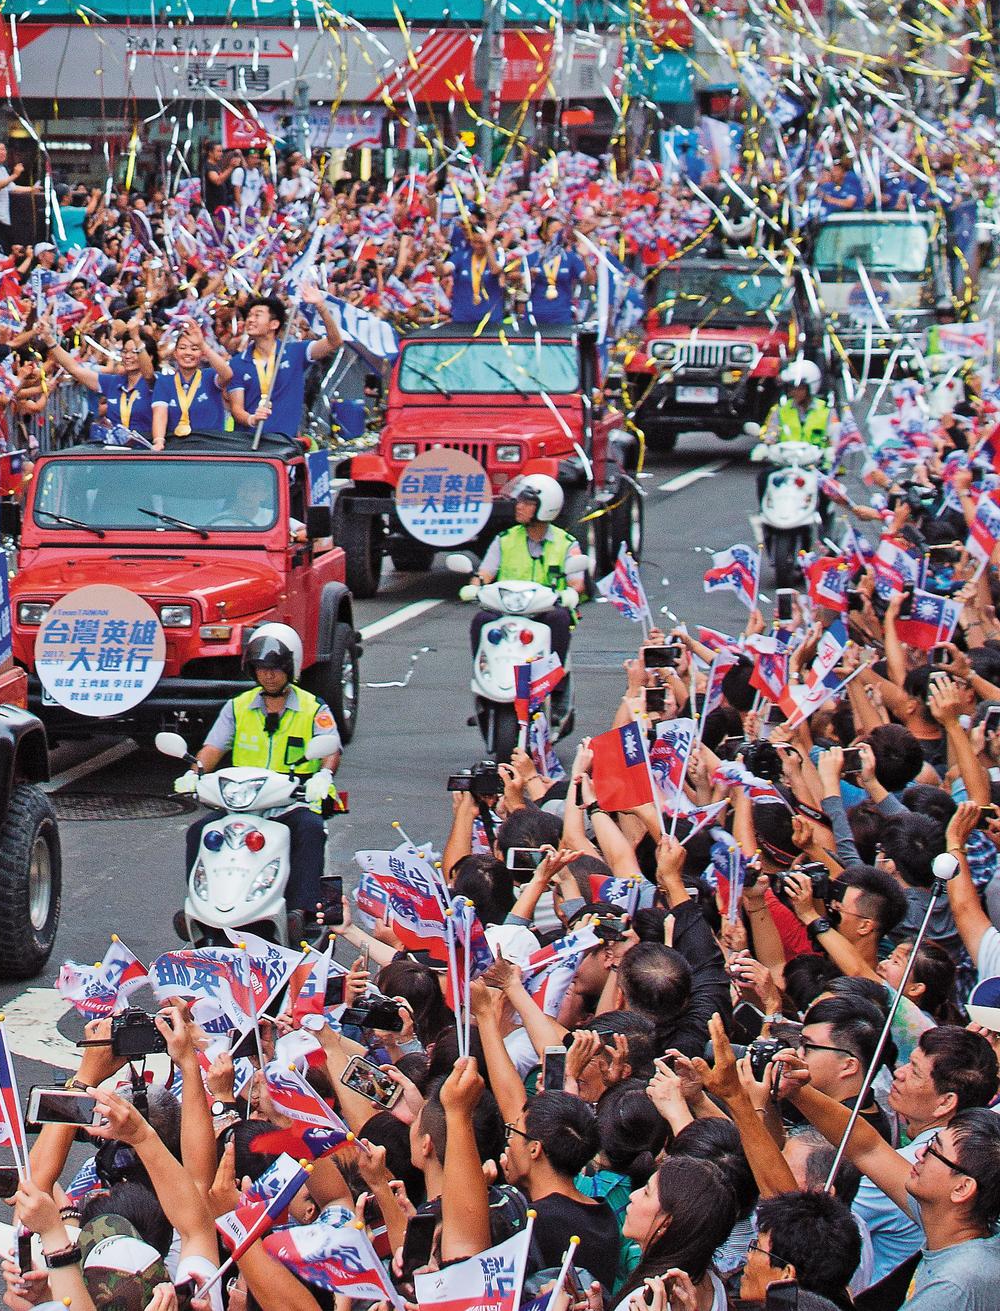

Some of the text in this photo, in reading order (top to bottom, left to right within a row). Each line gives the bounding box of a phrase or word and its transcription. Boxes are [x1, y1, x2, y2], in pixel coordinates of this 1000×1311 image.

[401, 474, 485, 493] 台灣英雄
[43, 619, 157, 645] 台灣英雄
[67, 647, 153, 672] 大遊行
